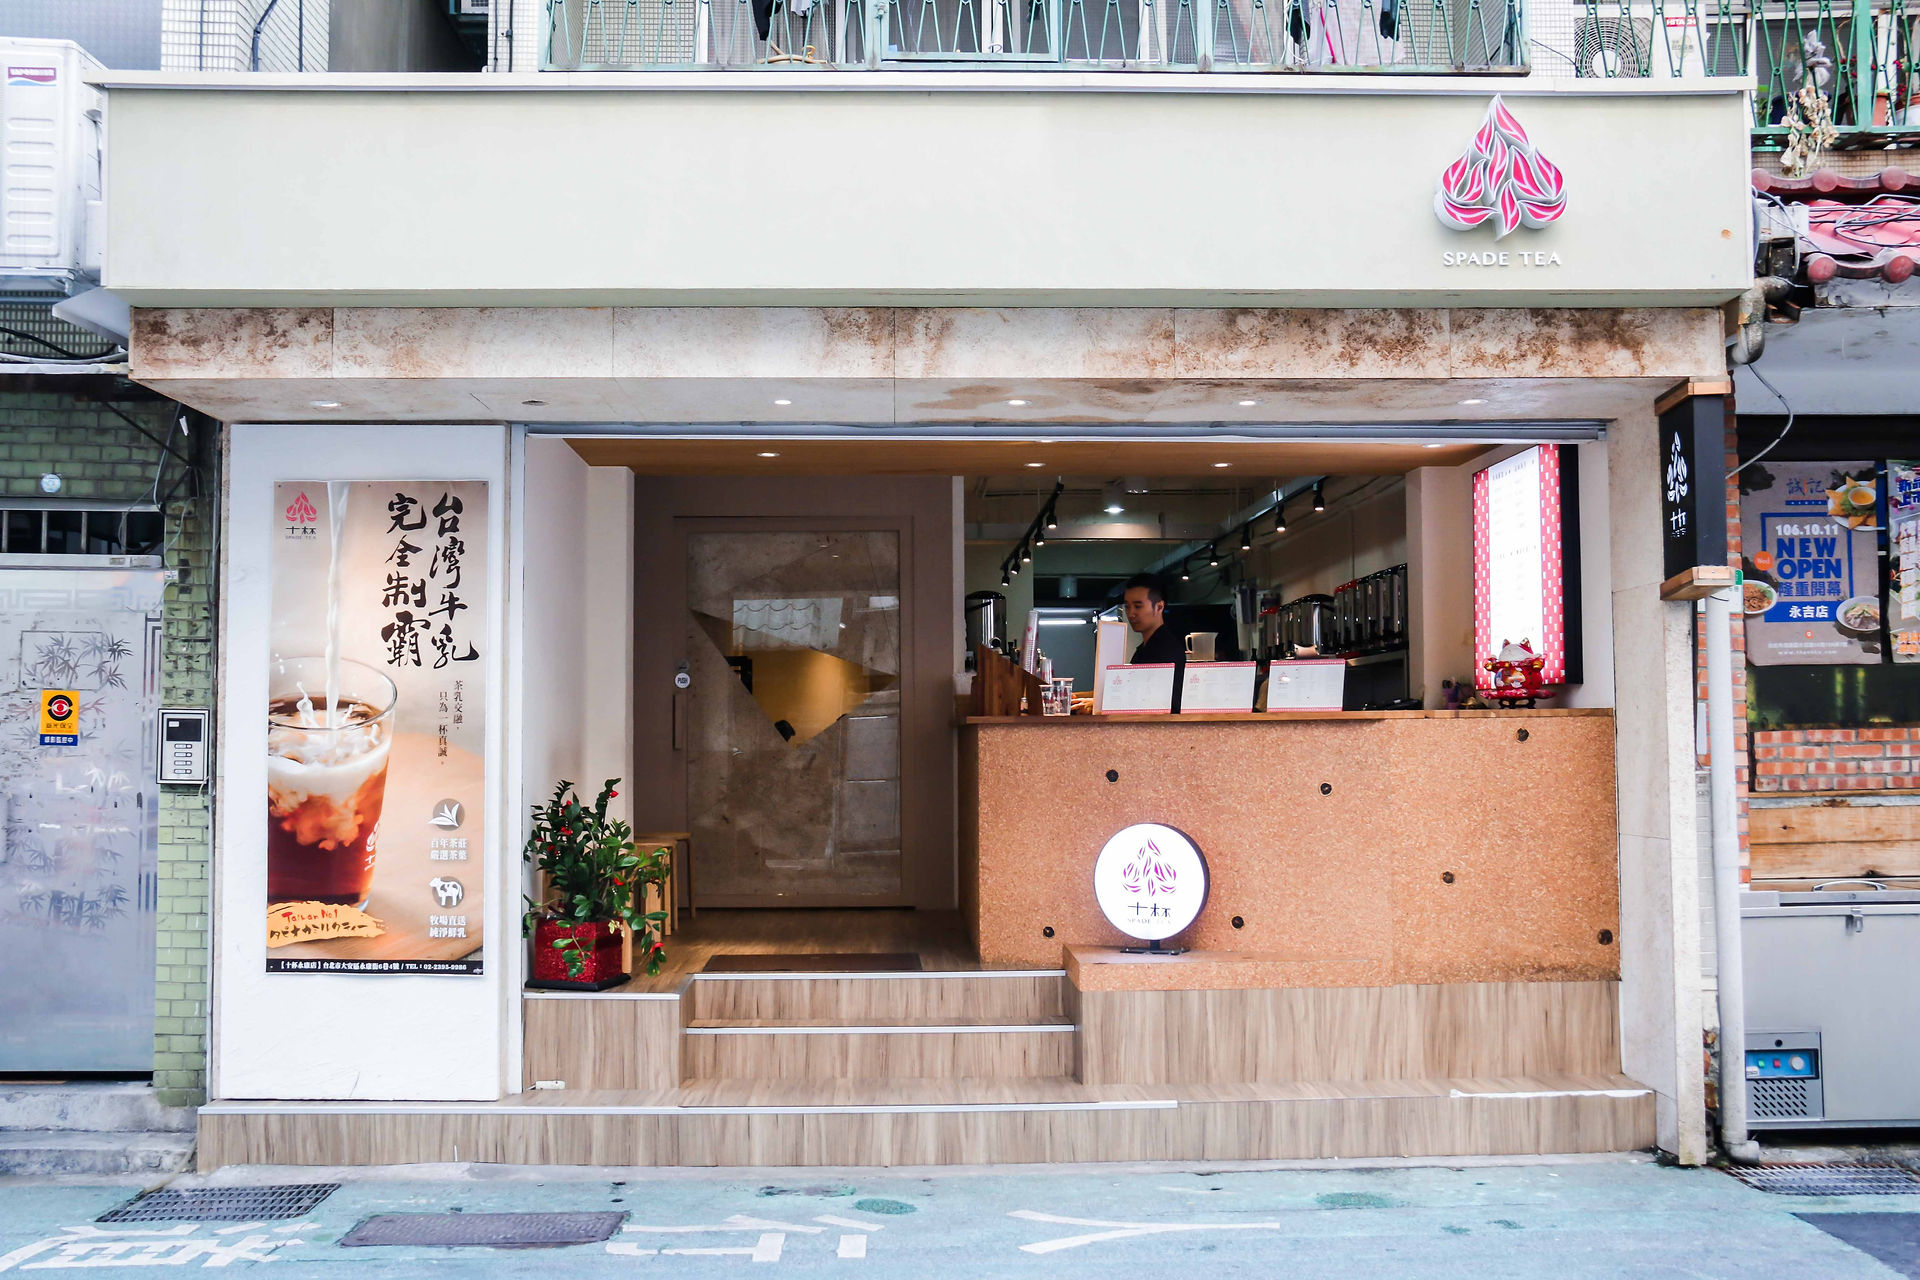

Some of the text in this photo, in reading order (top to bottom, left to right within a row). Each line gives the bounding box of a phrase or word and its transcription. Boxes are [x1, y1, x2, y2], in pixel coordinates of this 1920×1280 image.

[1443, 251, 1562, 267] SPADE TEA
[1775, 523, 1839, 536] 106.10.11
[1776, 537, 1837, 558] NEW
[1777, 559, 1842, 579] OPEN
[381, 492, 431, 668] 完全制霸
[428, 492, 480, 669] 台灣牛乳
[1778, 581, 1842, 597] 隆重開幕
[1789, 605, 1829, 619] 永吉店
